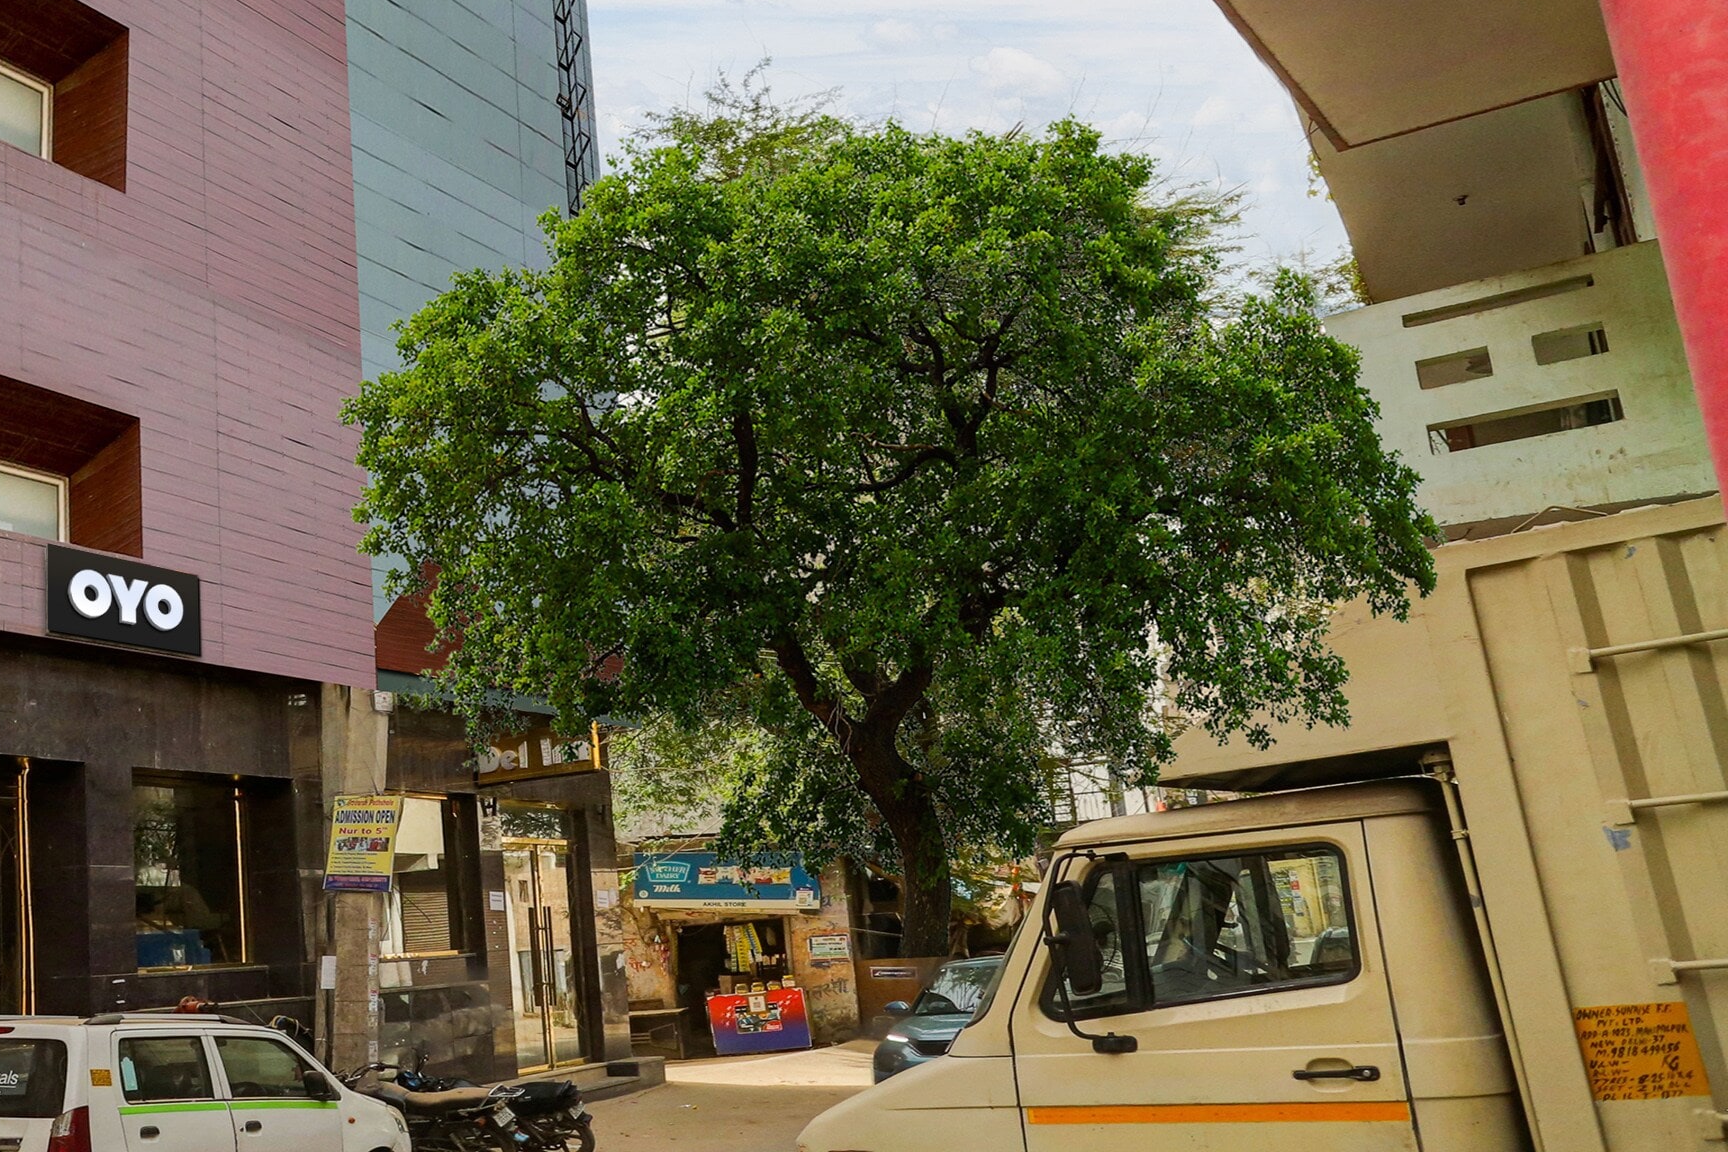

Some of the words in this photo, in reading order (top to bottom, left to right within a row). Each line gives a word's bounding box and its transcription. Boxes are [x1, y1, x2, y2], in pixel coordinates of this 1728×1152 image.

[67, 568, 184, 632] OYO
[335, 809, 374, 824] ADMISSION
[375, 809, 396, 824] OPEN
[338, 827, 358, 835] Nur
